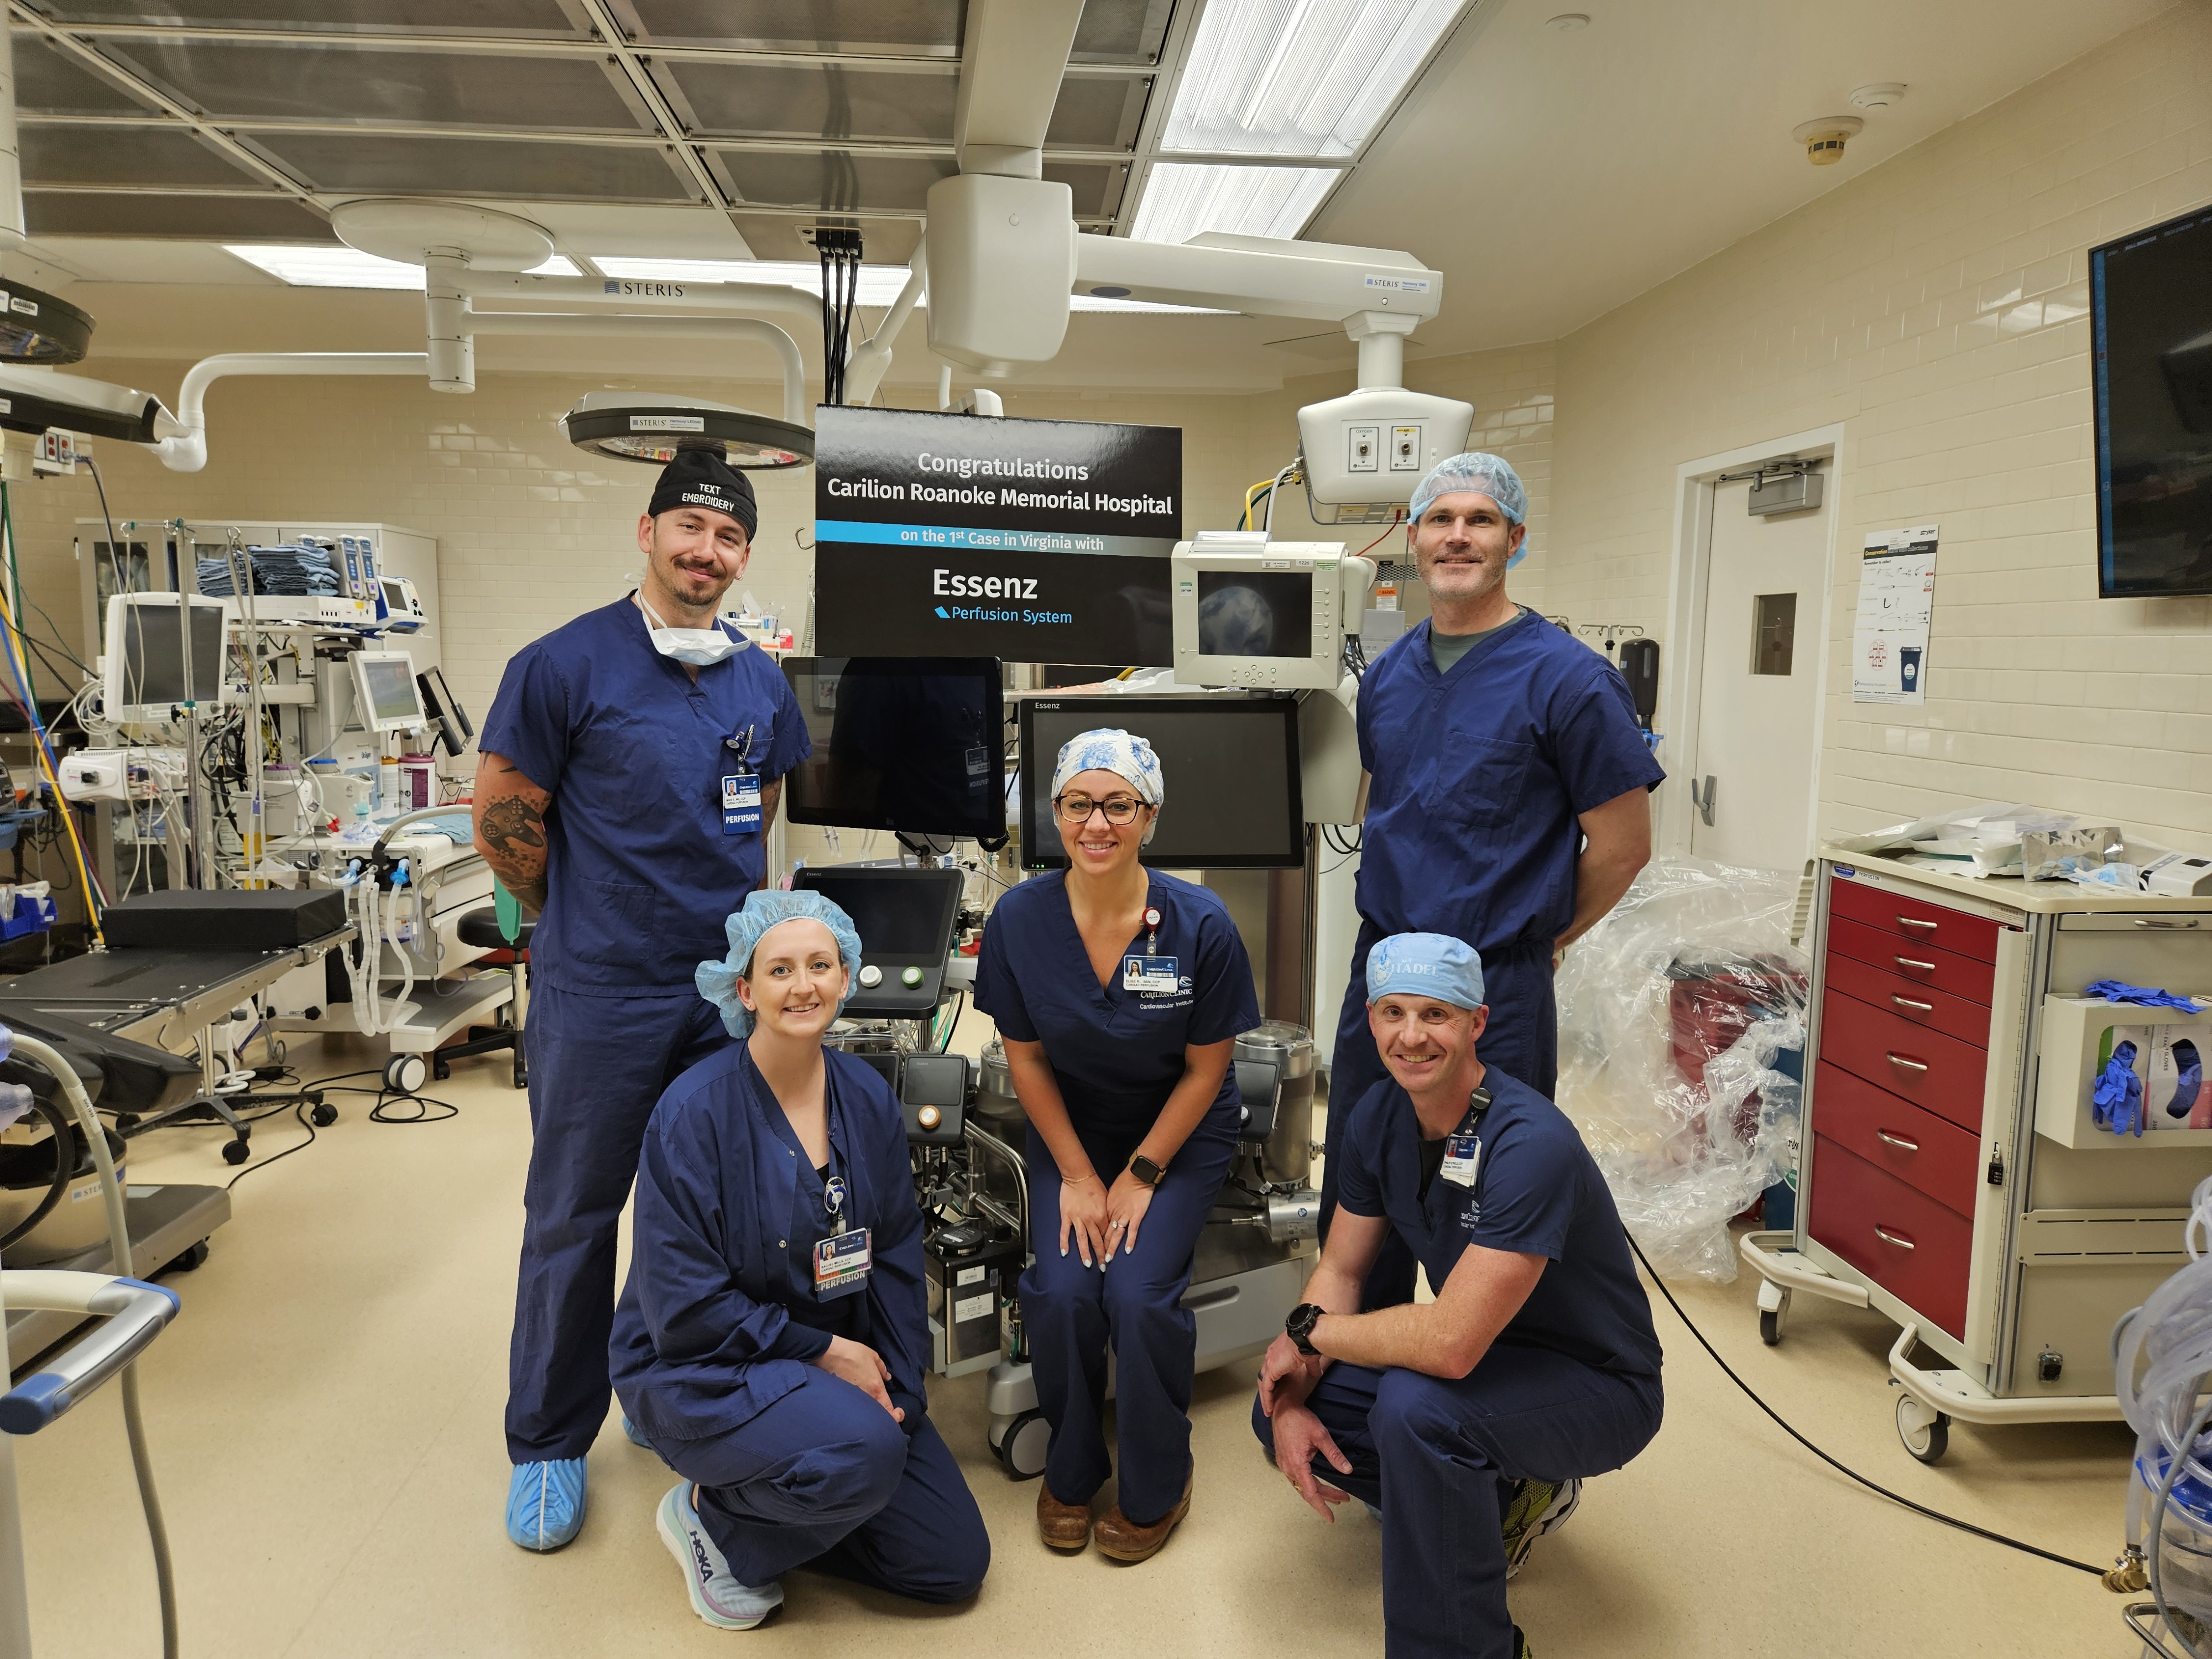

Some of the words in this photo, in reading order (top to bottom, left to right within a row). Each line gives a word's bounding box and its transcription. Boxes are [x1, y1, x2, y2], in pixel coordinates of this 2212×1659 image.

[624, 282, 683, 297] STERIS
[1374, 279, 1399, 288] STERIS
[918, 452, 1089, 480] Congratulations
[699, 483, 721, 495] TEXT
[827, 478, 905, 500] Carilion
[910, 483, 996, 505] Roanoke
[1000, 489, 1091, 511] Memorial
[1094, 494, 1173, 517] Hospital
[681, 493, 734, 512] EMBROIDERY
[900, 530, 918, 541] on
[922, 529, 946, 543] the
[949, 530, 965, 543] 1st
[968, 531, 1000, 546] Case
[1004, 533, 1017, 546] in
[1020, 534, 1072, 551] Virginia
[1075, 536, 1104, 551] with
[933, 568, 1038, 599] Essenz
[952, 606, 1018, 622] Perfusion
[1022, 609, 1072, 624] System
[726, 813, 759, 824] PERFUSION
[1859, 872, 1880, 881] PERFUSION
[84, 1185, 103, 1195] STER
[821, 1271, 865, 1291] PERFUSION
[690, 1530, 713, 1583] HOKA
